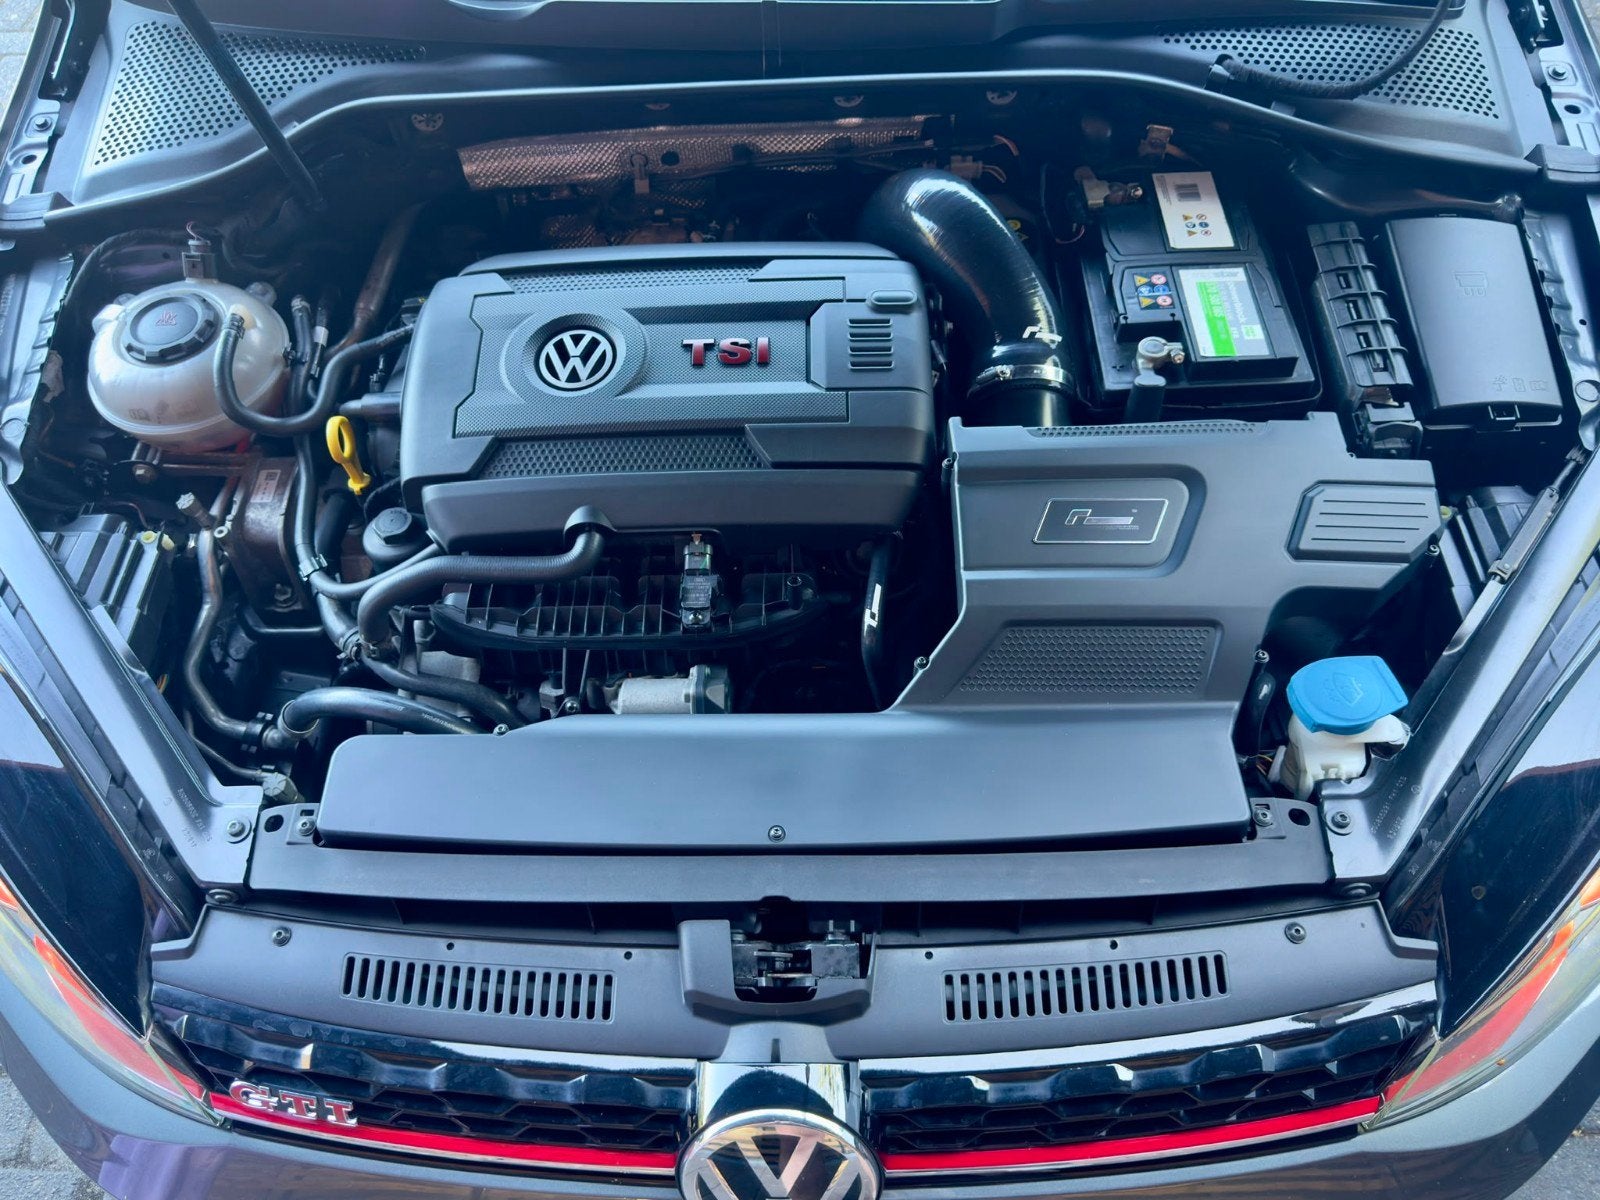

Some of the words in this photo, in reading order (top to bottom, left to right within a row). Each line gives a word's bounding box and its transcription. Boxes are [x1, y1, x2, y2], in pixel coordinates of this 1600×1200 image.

[540, 329, 613, 388] VW
[682, 336, 771, 367] TSI
[229, 1078, 358, 1127] GTI
